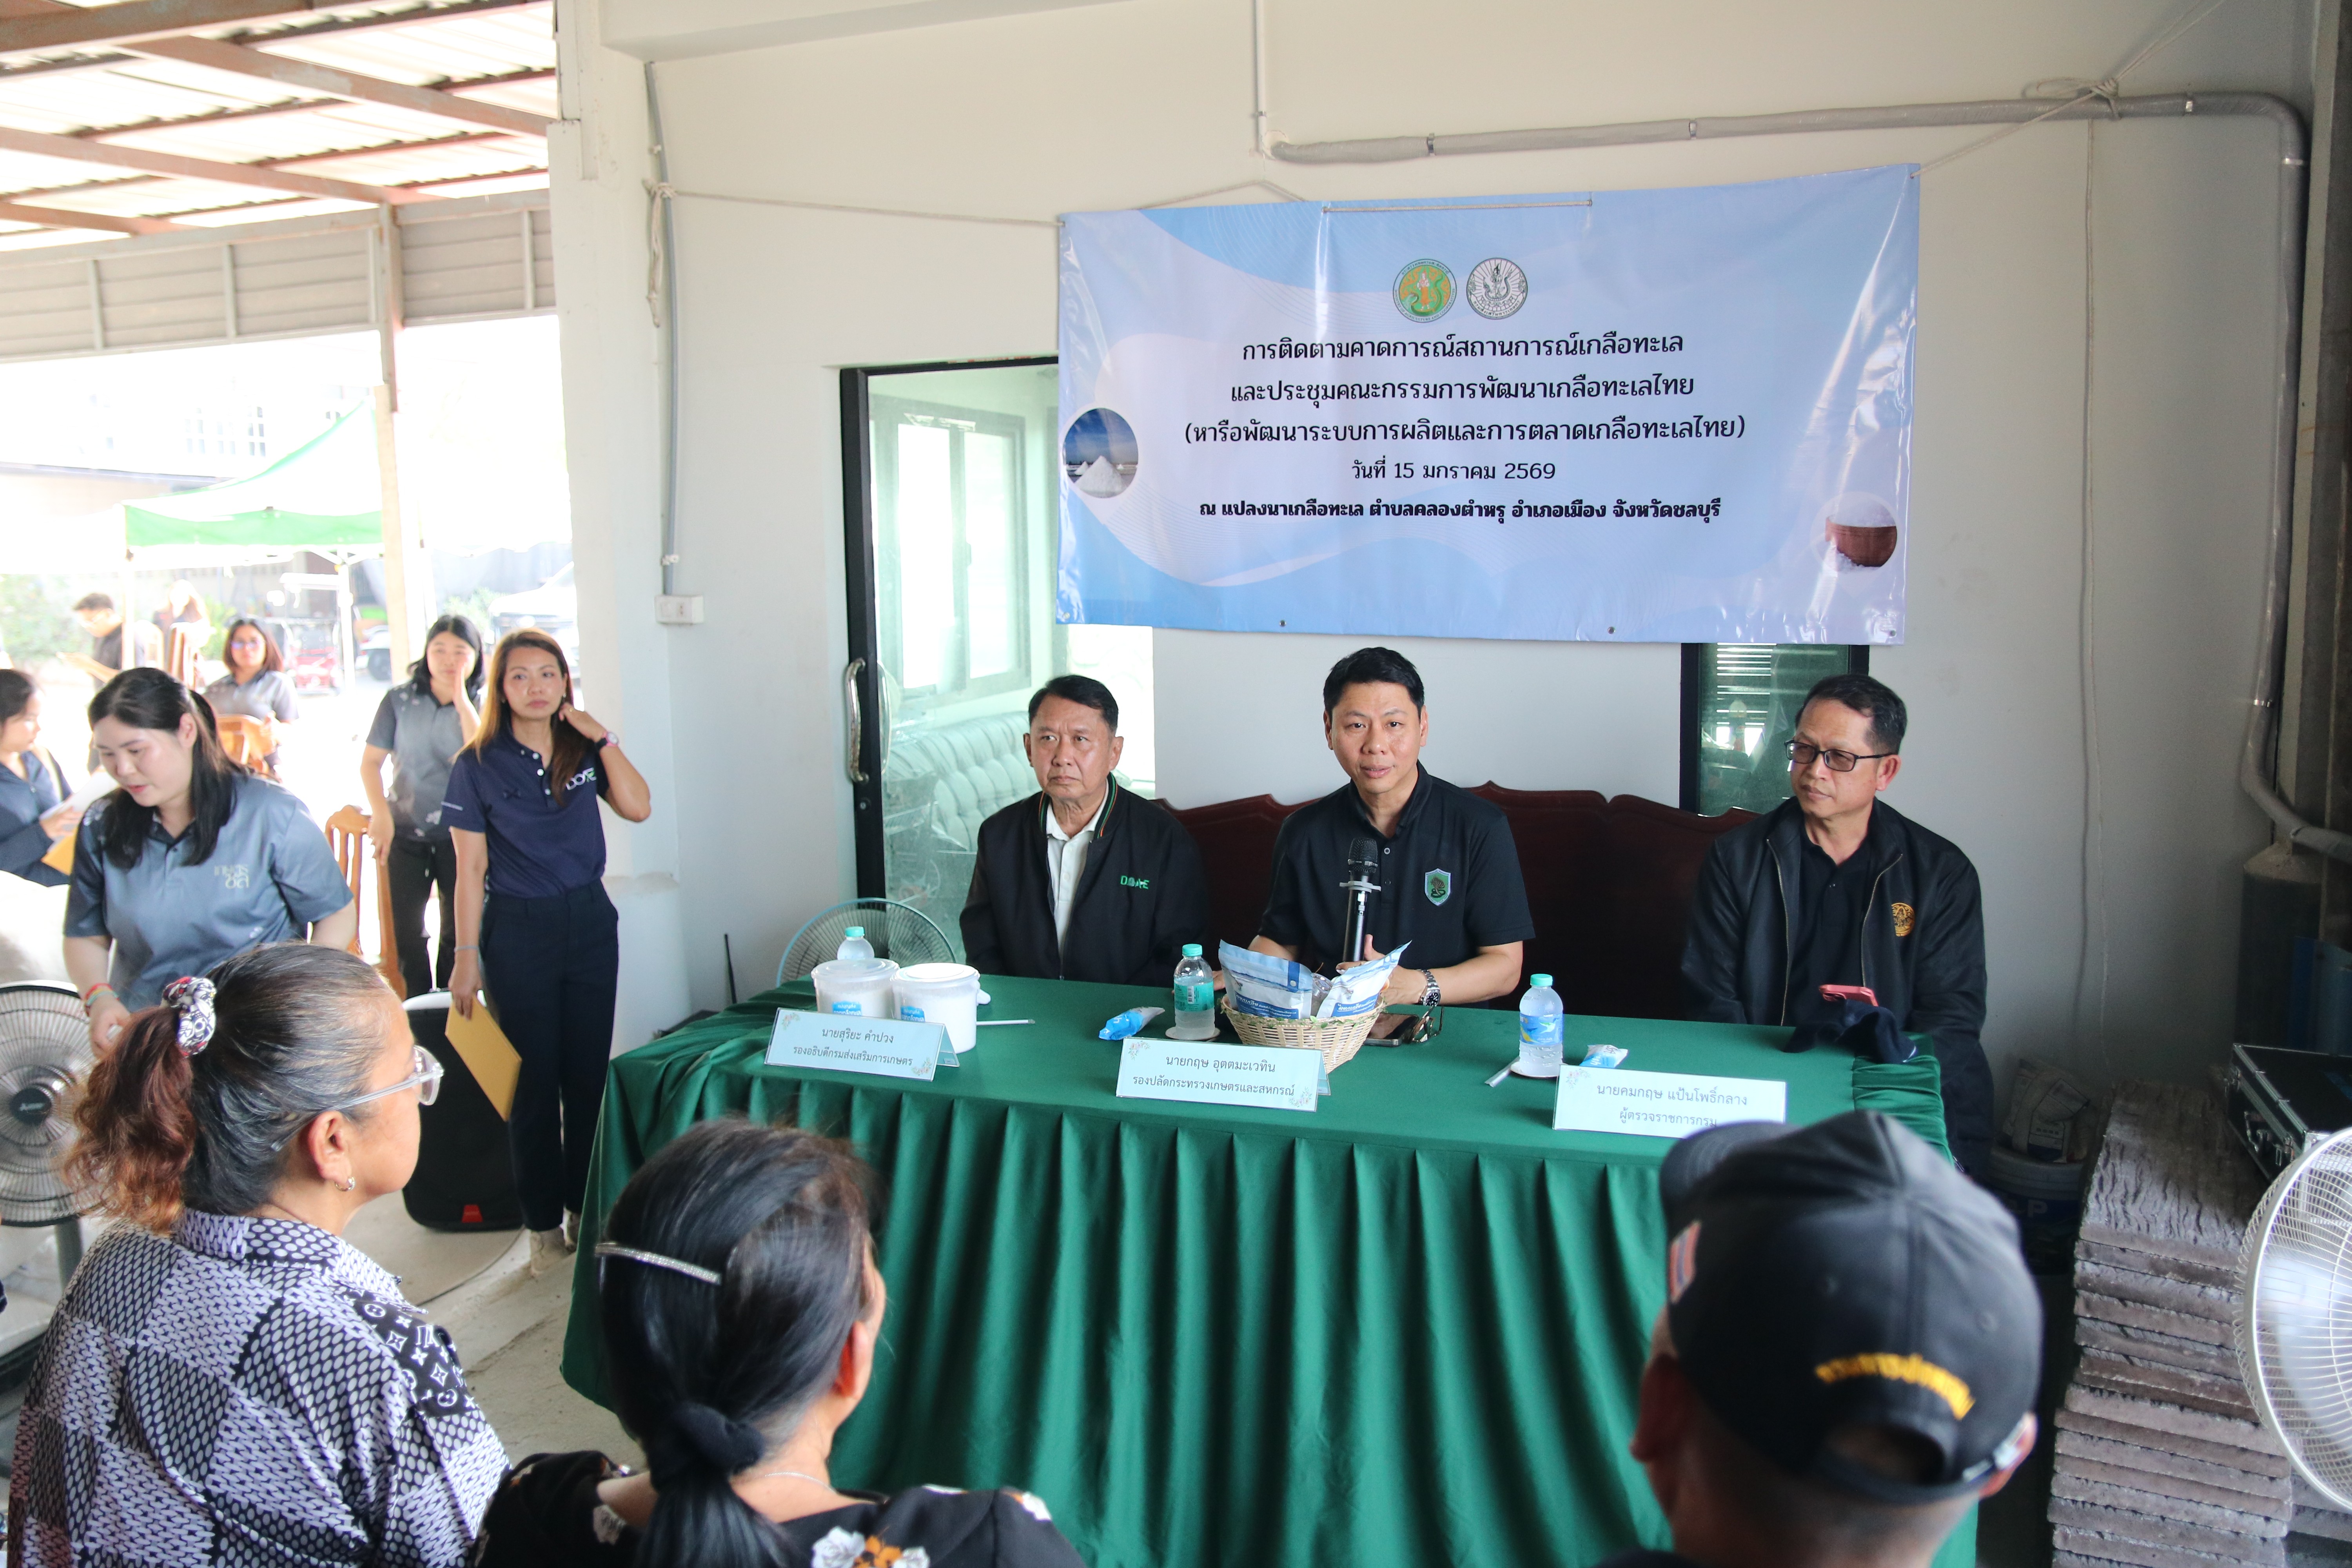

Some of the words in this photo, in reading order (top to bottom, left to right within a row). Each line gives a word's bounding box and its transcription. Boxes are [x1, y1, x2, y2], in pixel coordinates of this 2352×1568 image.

[1243, 331, 1682, 360] การติดตามคาดการณ์สถานการณ์เกลือทะเล
[1231, 373, 1693, 408] และประชุมคณะกรรมการพัฒนาเกลือทะเลไทย
[1185, 415, 1744, 444] (หารือพัฒนาระบบการผลิตและการตลาดเกลือทะเลไทย)
[1352, 455, 1385, 479] วันที่
[1395, 463, 1414, 478] 15
[1423, 465, 1495, 479] มกราคม
[1505, 463, 1555, 479] 2569
[1200, 504, 1216, 515] ณ
[1222, 498, 1363, 516] แปลงนาเกลือทะเล
[1370, 499, 1506, 524] ตำบลคลองตำหรุ
[1512, 499, 1606, 517] อำเภอเมือง
[1613, 497, 1721, 523] จังหวัดชลบุรี
[822, 1028, 861, 1042] นายสุริยะ
[865, 1030, 893, 1043] คำปวง
[794, 1045, 913, 1065] รองอธิบดีกรมส่งเสริมการเกษตร
[1166, 1057, 1209, 1069] นายกฤษ
[1214, 1060, 1275, 1073] อุตตมะเวทิน
[1133, 1075, 1295, 1096] รองปลัดกระทรวงเกษตรและสหกรณ์
[1597, 1085, 1663, 1100] นายคมกฤษ
[1668, 1087, 1746, 1105] แป้นโพธิ์กลาง
[1620, 1107, 1717, 1127] ผู้ตรวจราชการกรม
